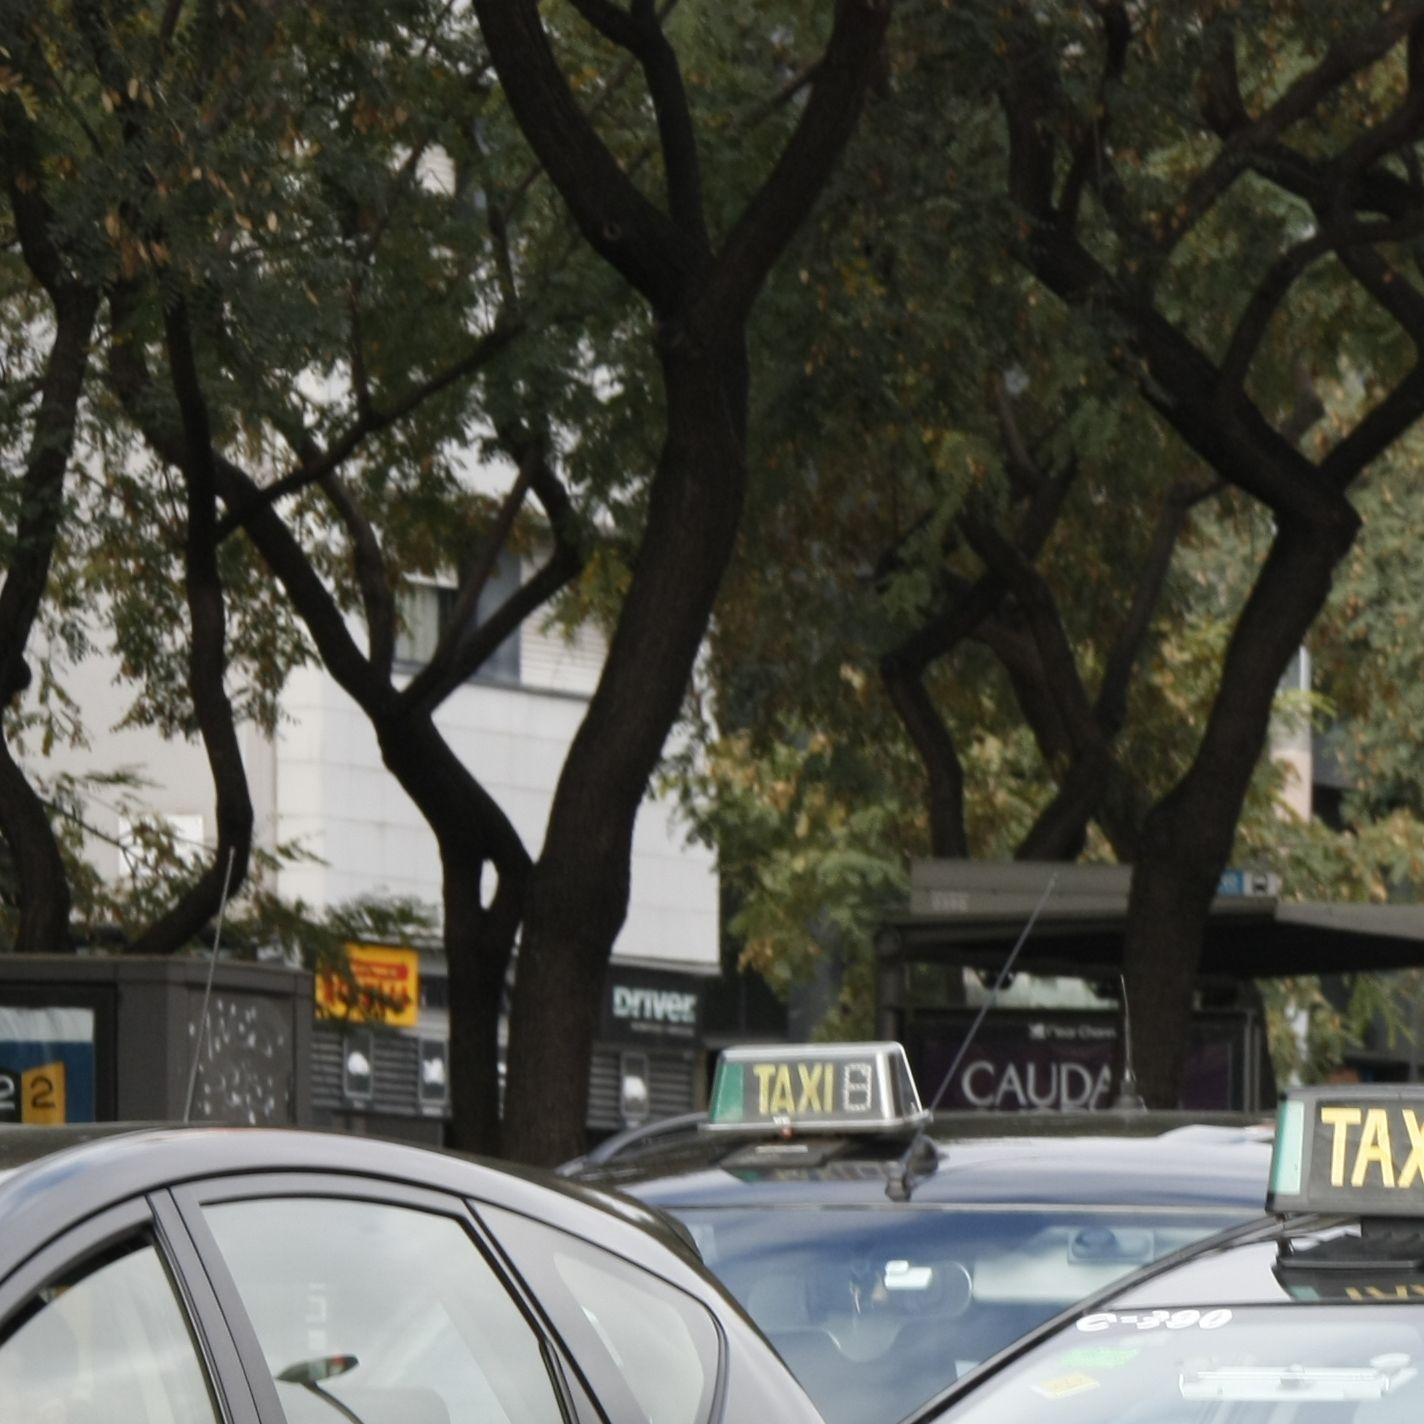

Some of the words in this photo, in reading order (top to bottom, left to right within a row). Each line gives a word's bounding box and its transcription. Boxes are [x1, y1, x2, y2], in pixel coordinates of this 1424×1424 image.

[613, 985, 697, 1022] Driver
[31, 1076, 55, 1109] 2
[753, 1062, 834, 1115] TAXI
